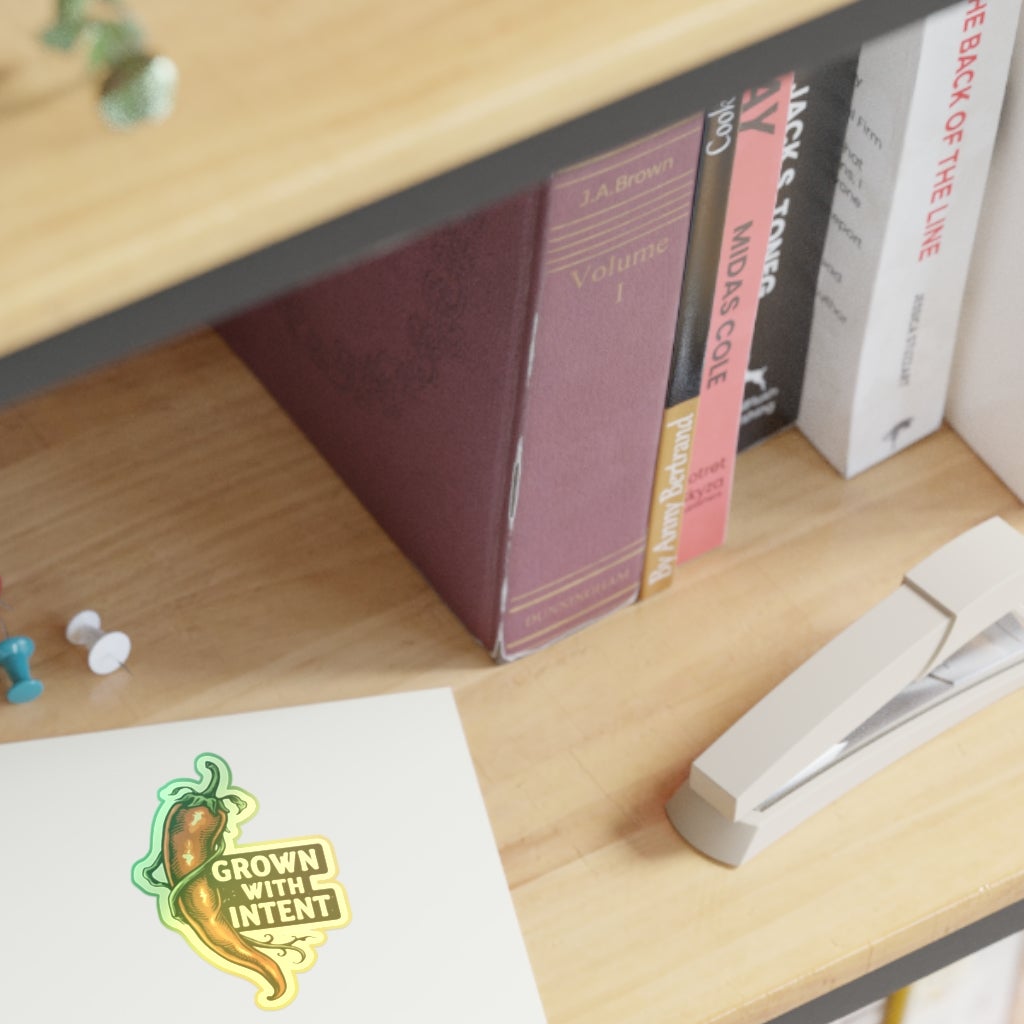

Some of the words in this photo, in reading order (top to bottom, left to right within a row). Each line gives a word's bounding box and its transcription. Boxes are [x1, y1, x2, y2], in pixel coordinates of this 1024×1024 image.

[949, 32, 982, 108] BACK
[942, 111, 967, 146] OF
[931, 149, 960, 204] THE
[918, 204, 948, 262] LINE
[570, 237, 670, 289] Volume
[720, 220, 753, 316] MIDAS
[707, 320, 735, 391] COLE
[659, 413, 695, 505] Bertrand
[648, 555, 677, 586] By
[211, 849, 320, 882] GROWN
[241, 876, 305, 900] WITH
[229, 894, 331, 928] INTENT
